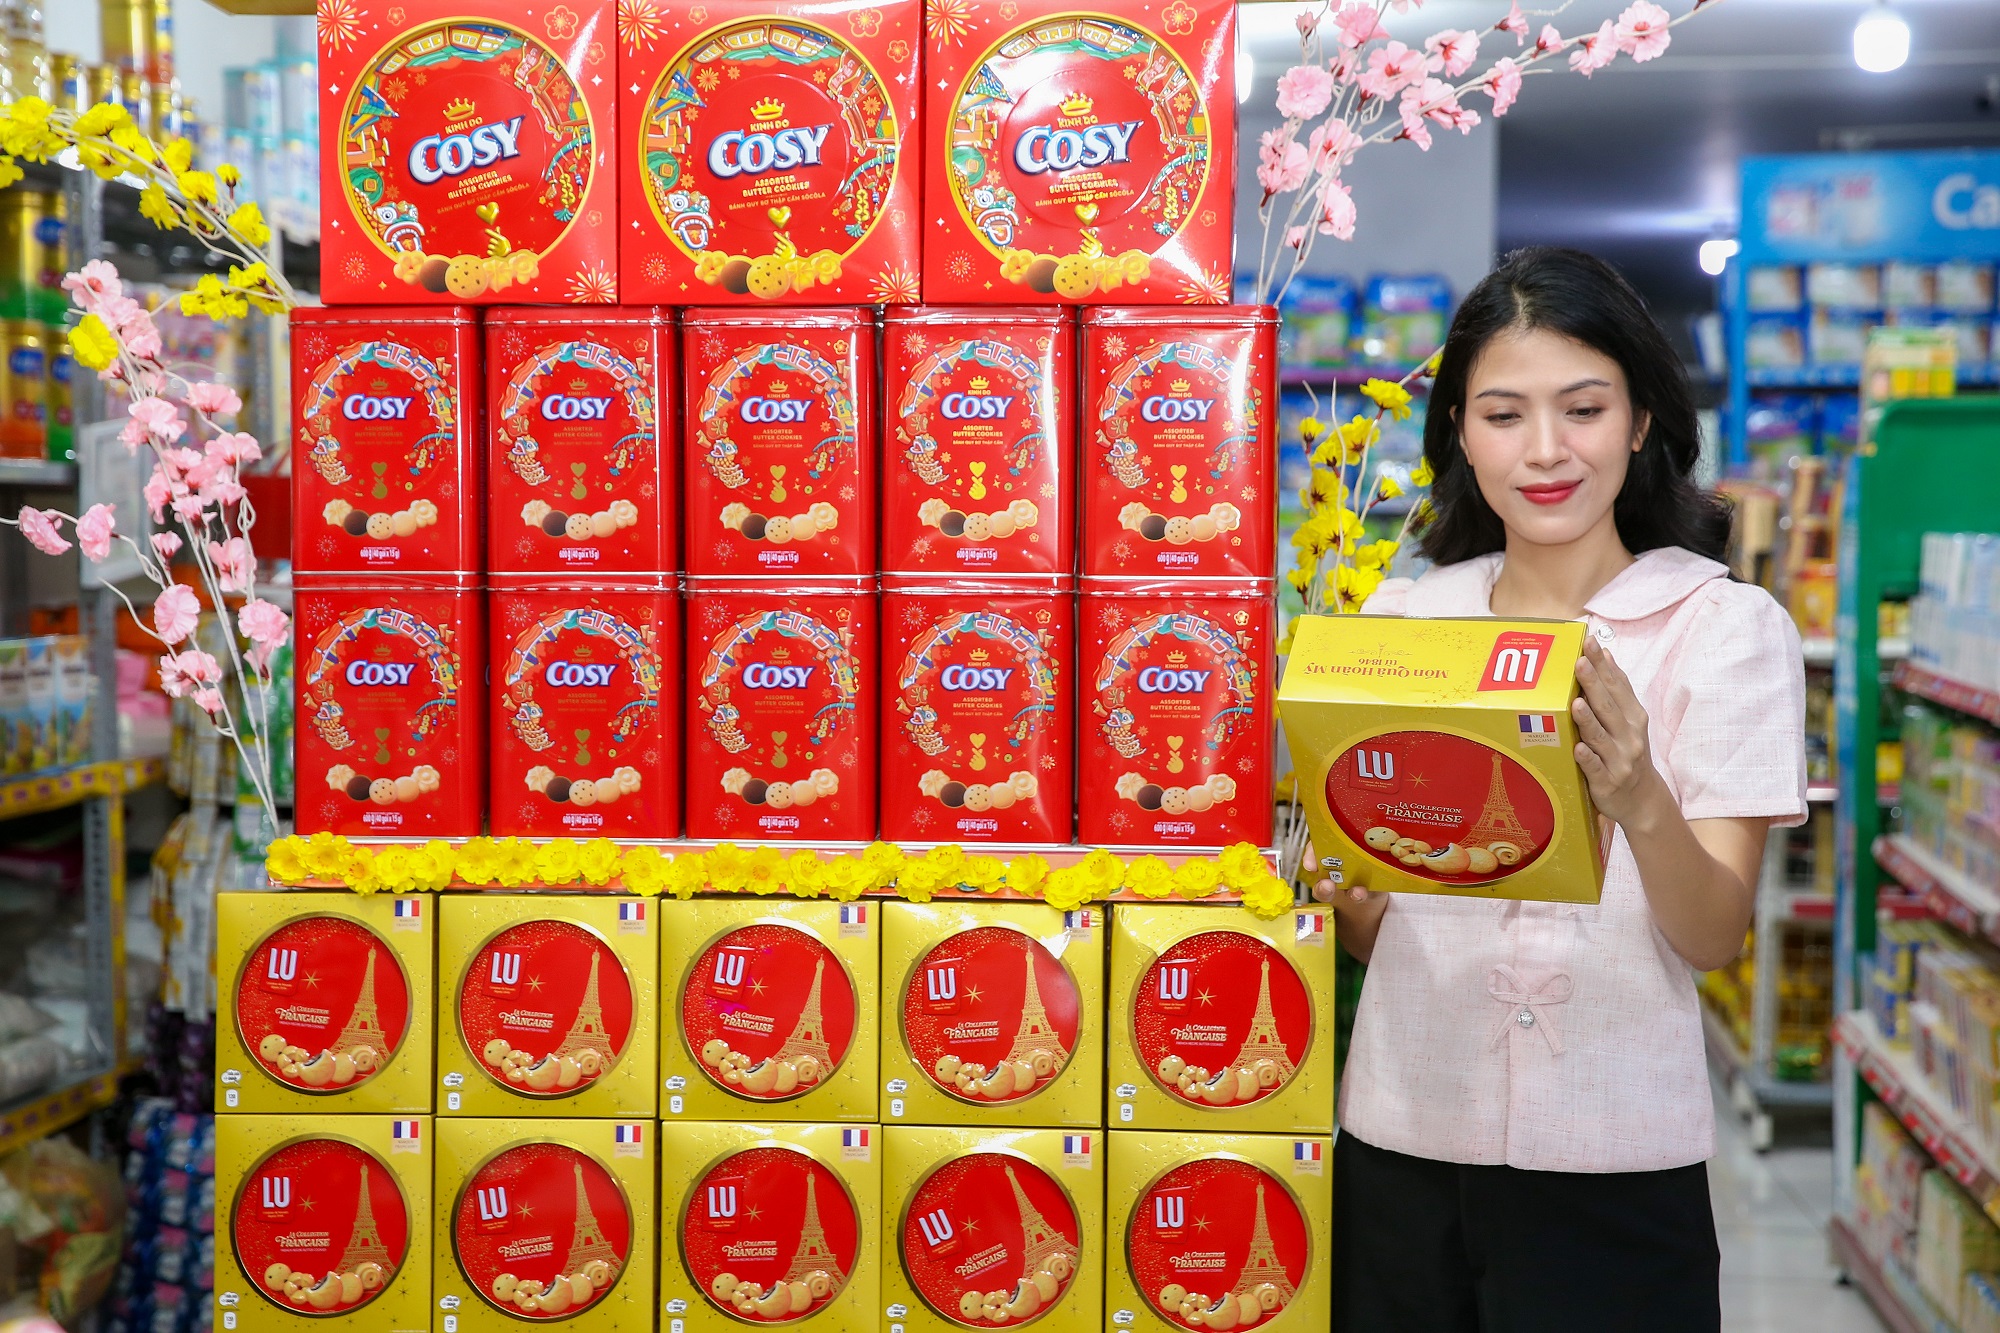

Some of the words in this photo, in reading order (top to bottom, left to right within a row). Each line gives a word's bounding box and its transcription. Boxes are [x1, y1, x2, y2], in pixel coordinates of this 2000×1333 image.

[445, 123, 468, 134] KINH
[750, 122, 774, 132] KINH
[1057, 118, 1081, 128] KINH
[408, 114, 525, 184] COSY
[708, 123, 834, 179] COSY
[1014, 120, 1144, 175] COSY
[448, 186, 476, 199] BUTTER
[478, 175, 512, 190] COOKIES
[459, 170, 498, 188] ASSORTED
[742, 186, 772, 197] BUTTER
[774, 181, 810, 193] COOKIES
[755, 175, 796, 187] ASSORTED
[1049, 183, 1080, 194] BUTTER
[1081, 179, 1118, 189] COOKIES
[1062, 172, 1103, 184] ASSORTED
[342, 393, 415, 421] COSY
[540, 394, 614, 421] COSY
[739, 396, 814, 424] COSY
[940, 392, 1015, 420] COSY
[1141, 395, 1216, 423] COSY
[345, 659, 418, 687] COSY
[545, 661, 619, 687] COSY
[742, 662, 816, 689] COSY
[940, 664, 1015, 691] COSY
[1493, 648, 1539, 682] LU
[1137, 666, 1213, 694] COSY
[1356, 749, 1394, 780] LU
[1410, 803, 1461, 814] COLLECTION
[268, 947, 297, 981] LU
[491, 951, 520, 985] LU
[714, 952, 745, 986] LU
[927, 967, 956, 1001] LU
[1160, 967, 1188, 1000] LU
[262, 1177, 290, 1208] LU
[478, 1187, 508, 1220] LU
[708, 1186, 736, 1218] LU
[1155, 1196, 1184, 1228] LU
[919, 1209, 954, 1247] LU
